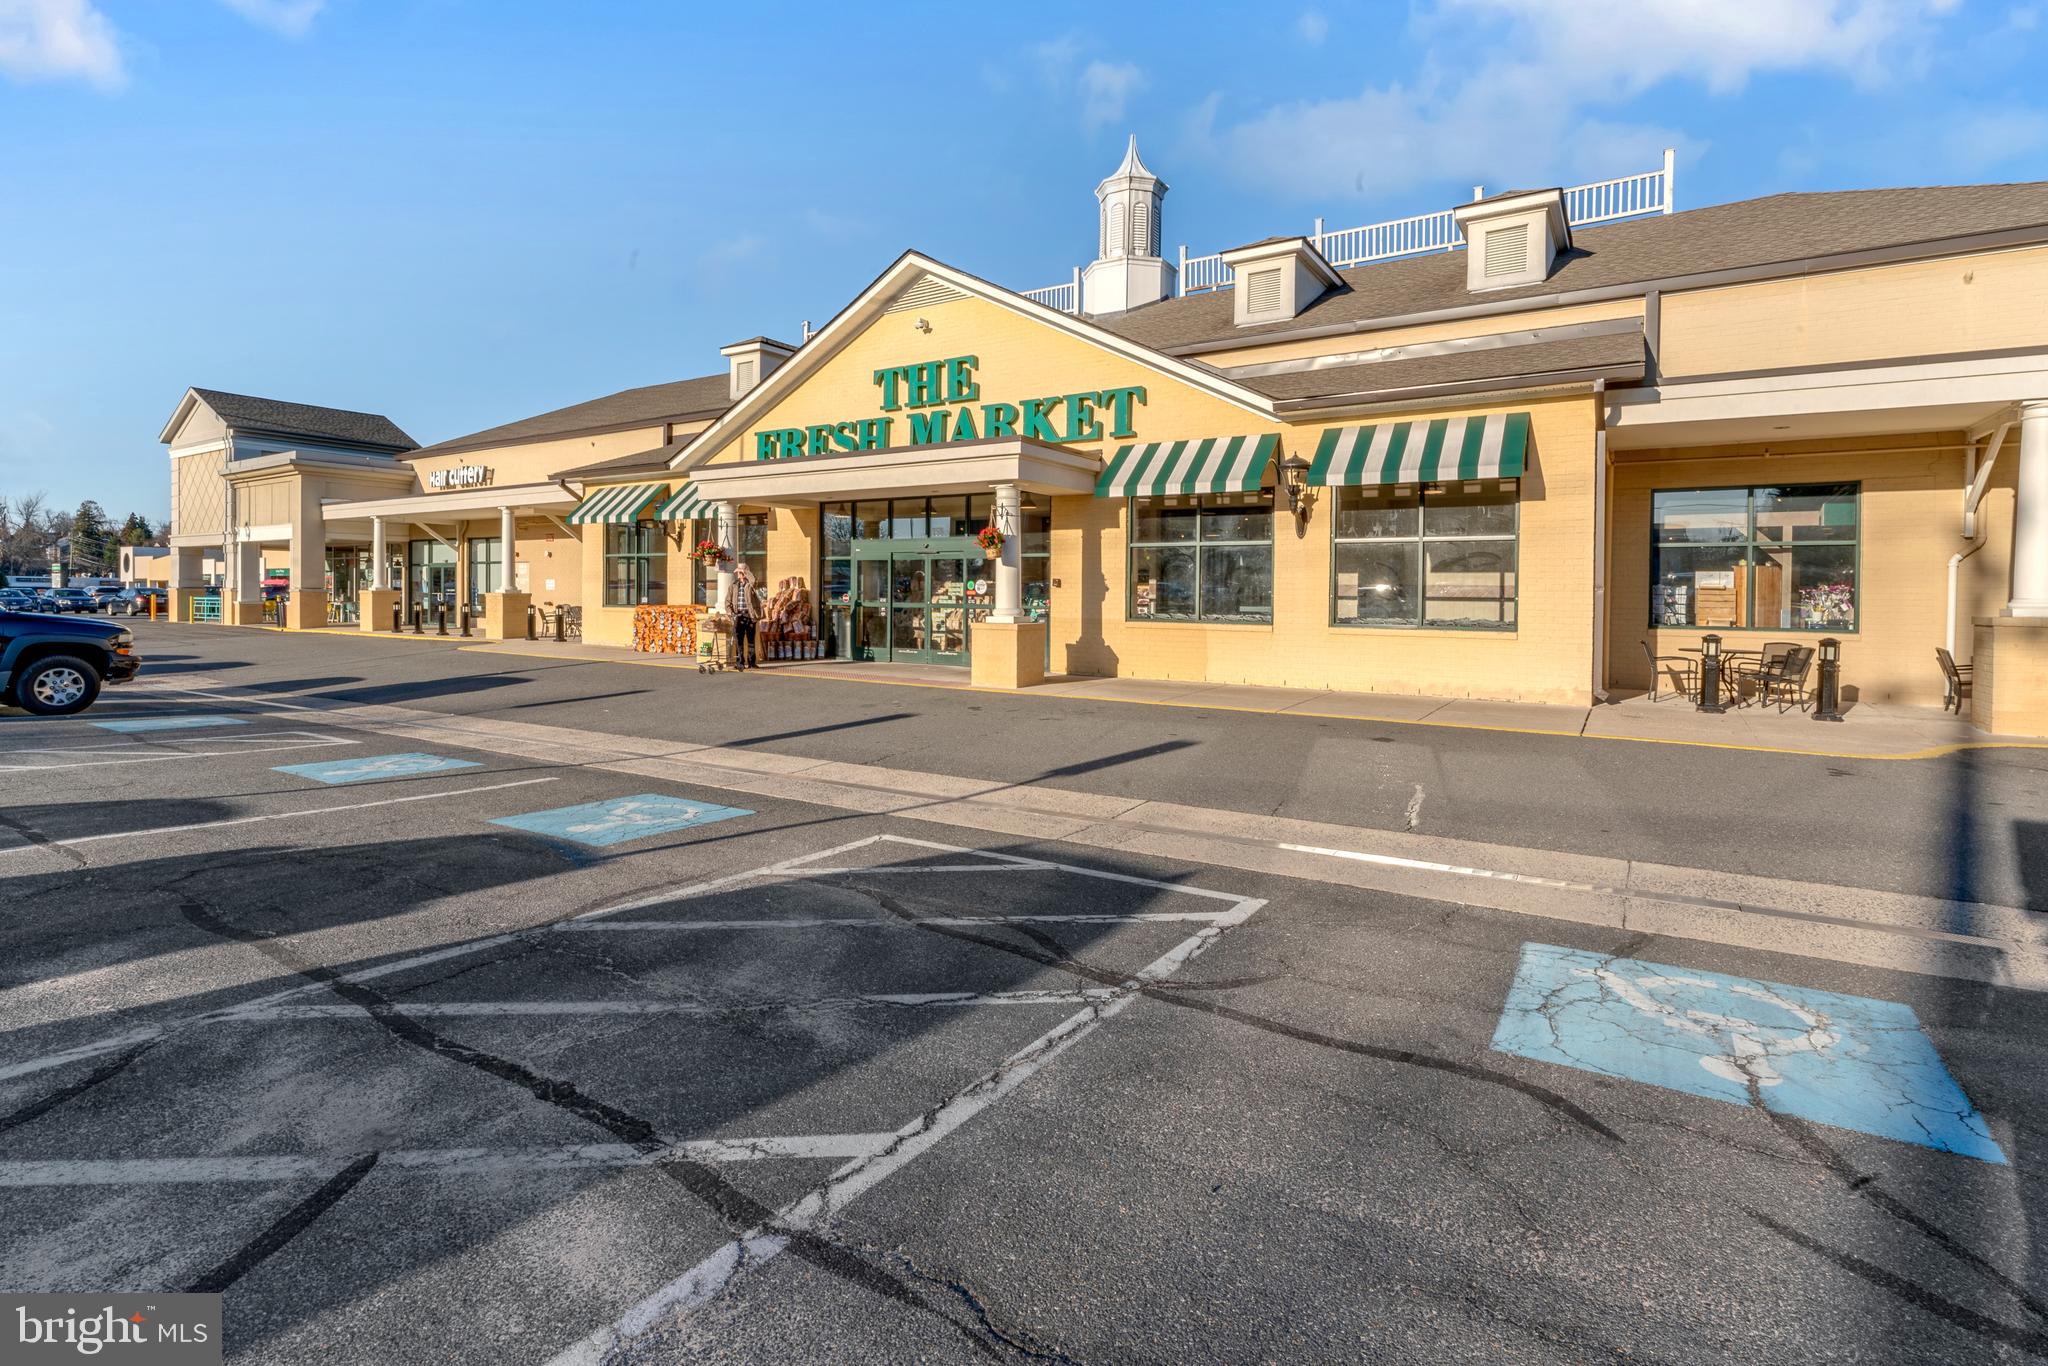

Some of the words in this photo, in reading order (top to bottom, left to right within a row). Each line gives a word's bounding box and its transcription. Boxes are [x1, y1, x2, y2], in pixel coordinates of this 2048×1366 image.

[873, 355, 980, 412] THE
[755, 417, 894, 461] FRESH
[907, 386, 1147, 445] MARKET
[429, 470, 447, 487] Hair
